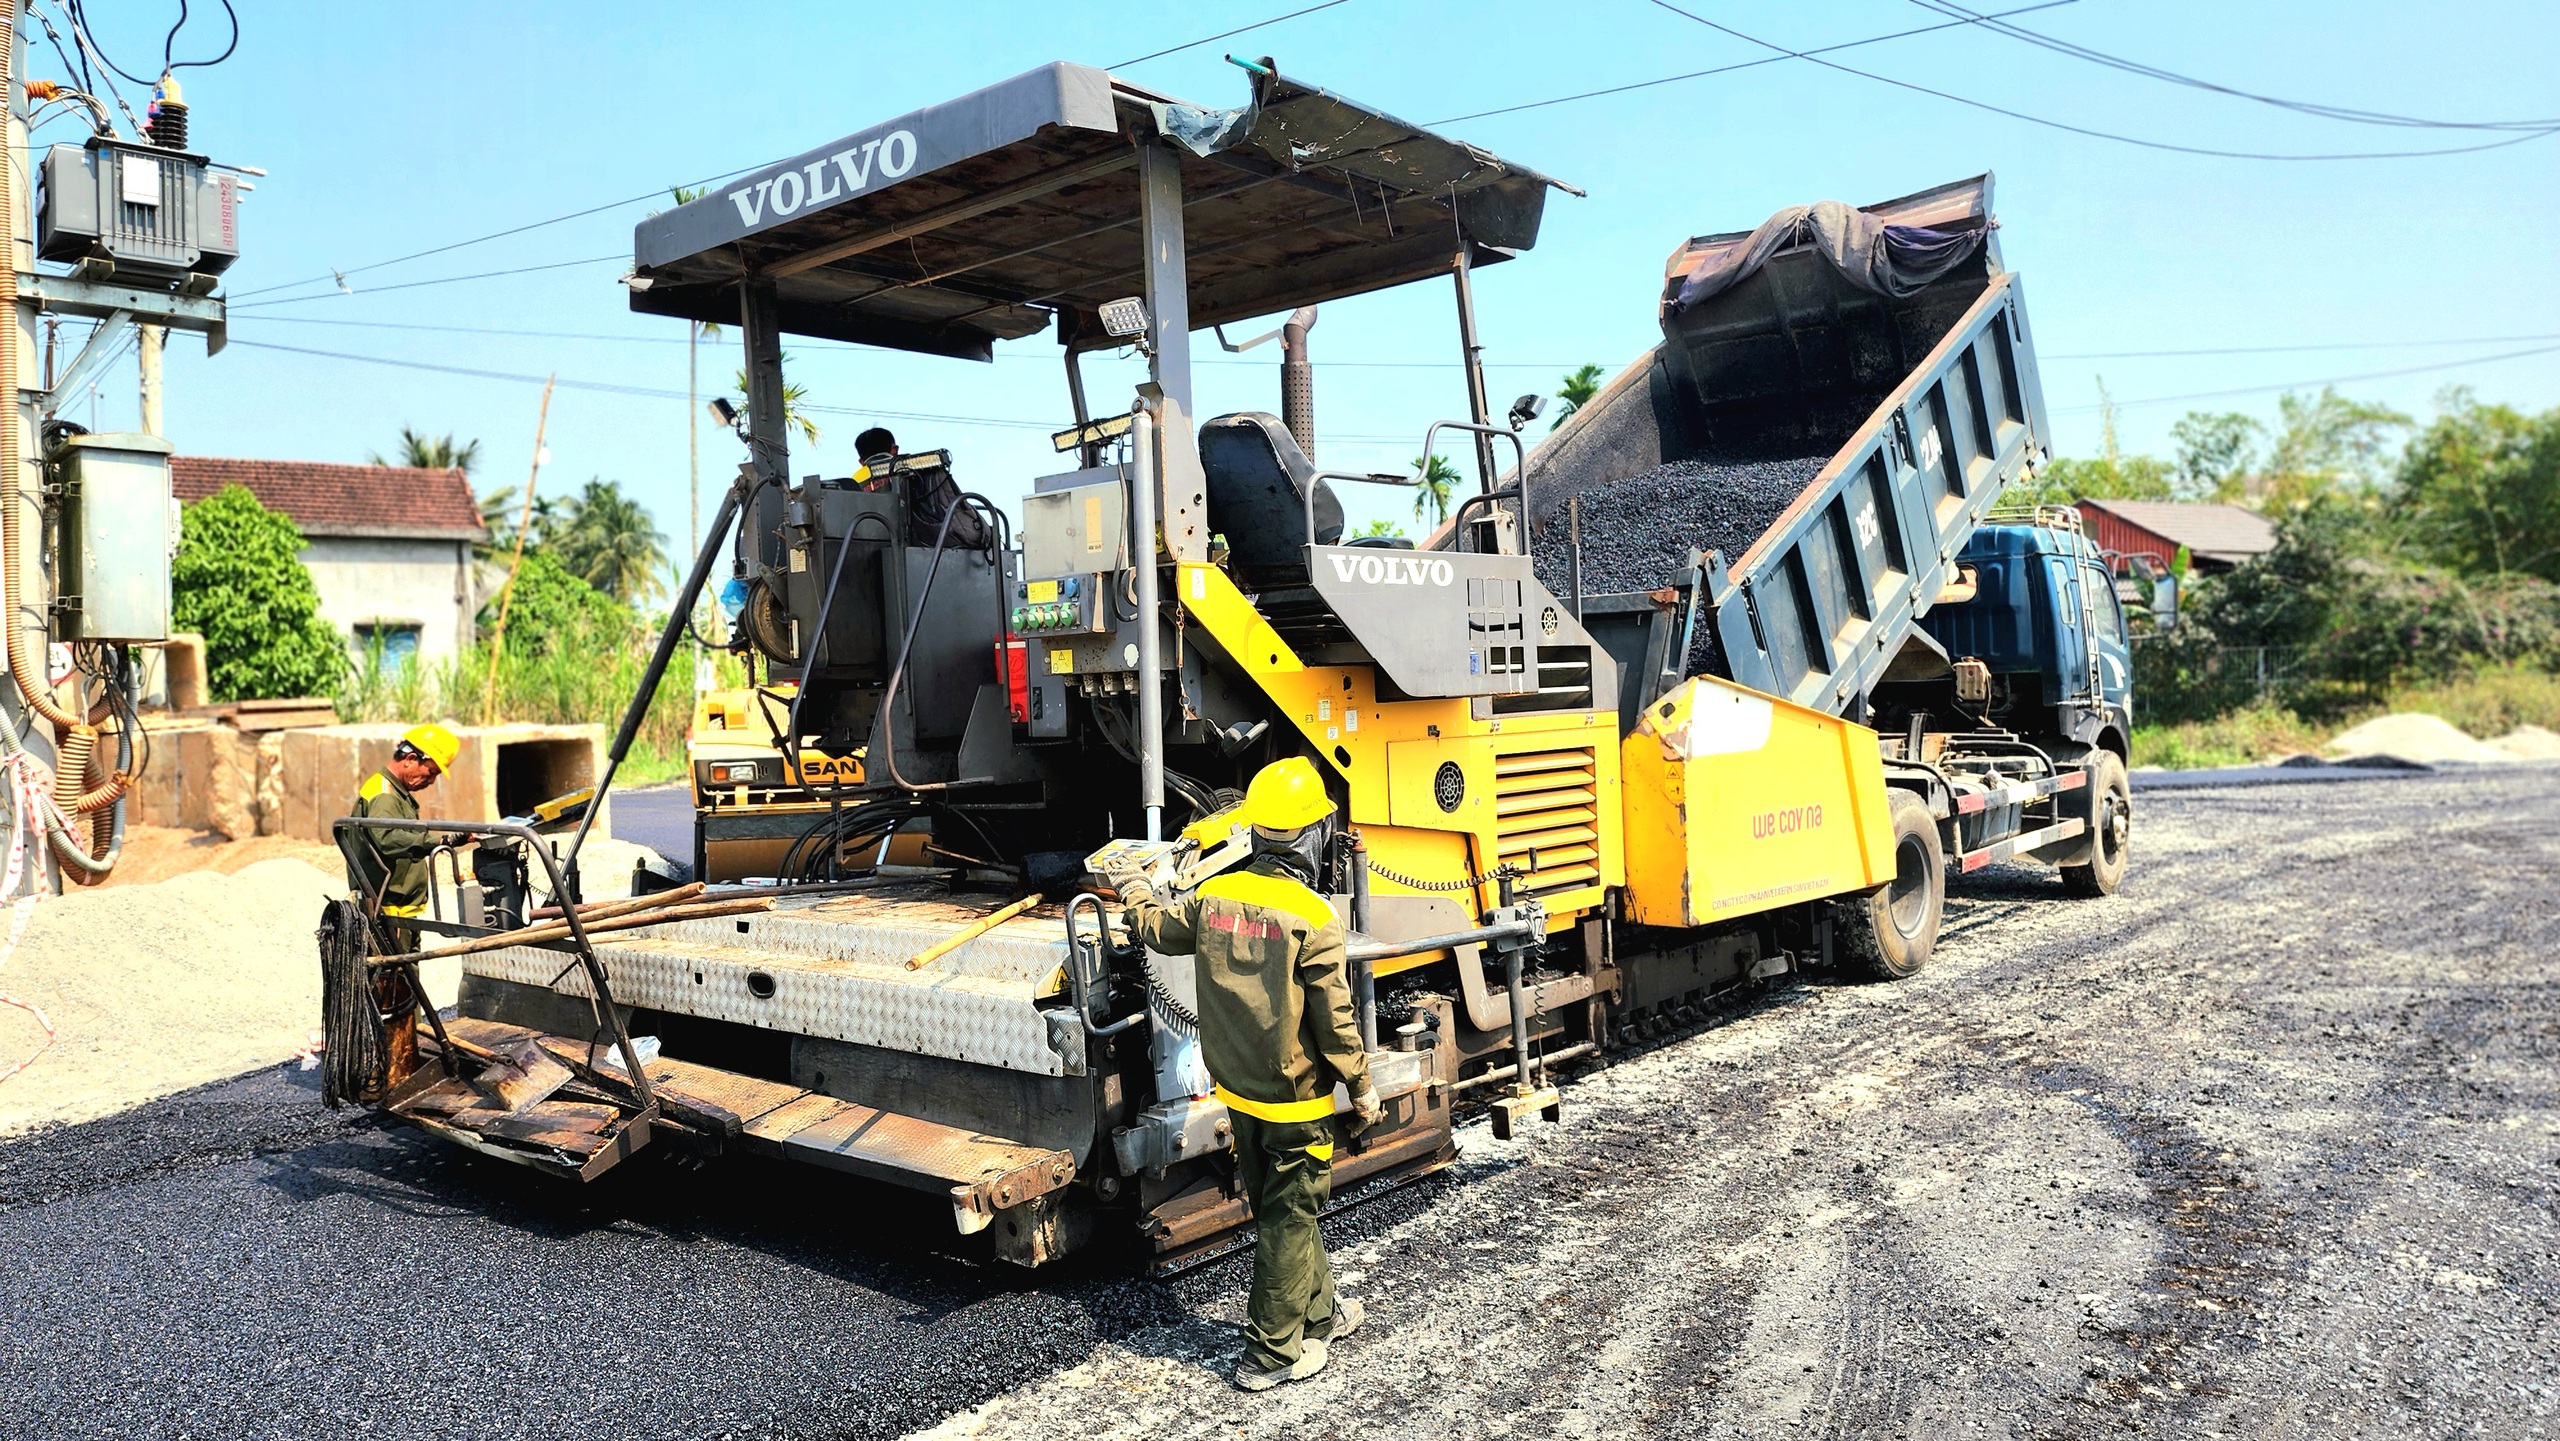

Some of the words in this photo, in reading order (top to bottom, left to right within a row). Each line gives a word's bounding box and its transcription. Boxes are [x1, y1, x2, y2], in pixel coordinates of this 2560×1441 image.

[728, 130, 918, 228] VOLVO
[1327, 553, 1454, 587] VOLVO
[803, 760, 857, 775] SAN
